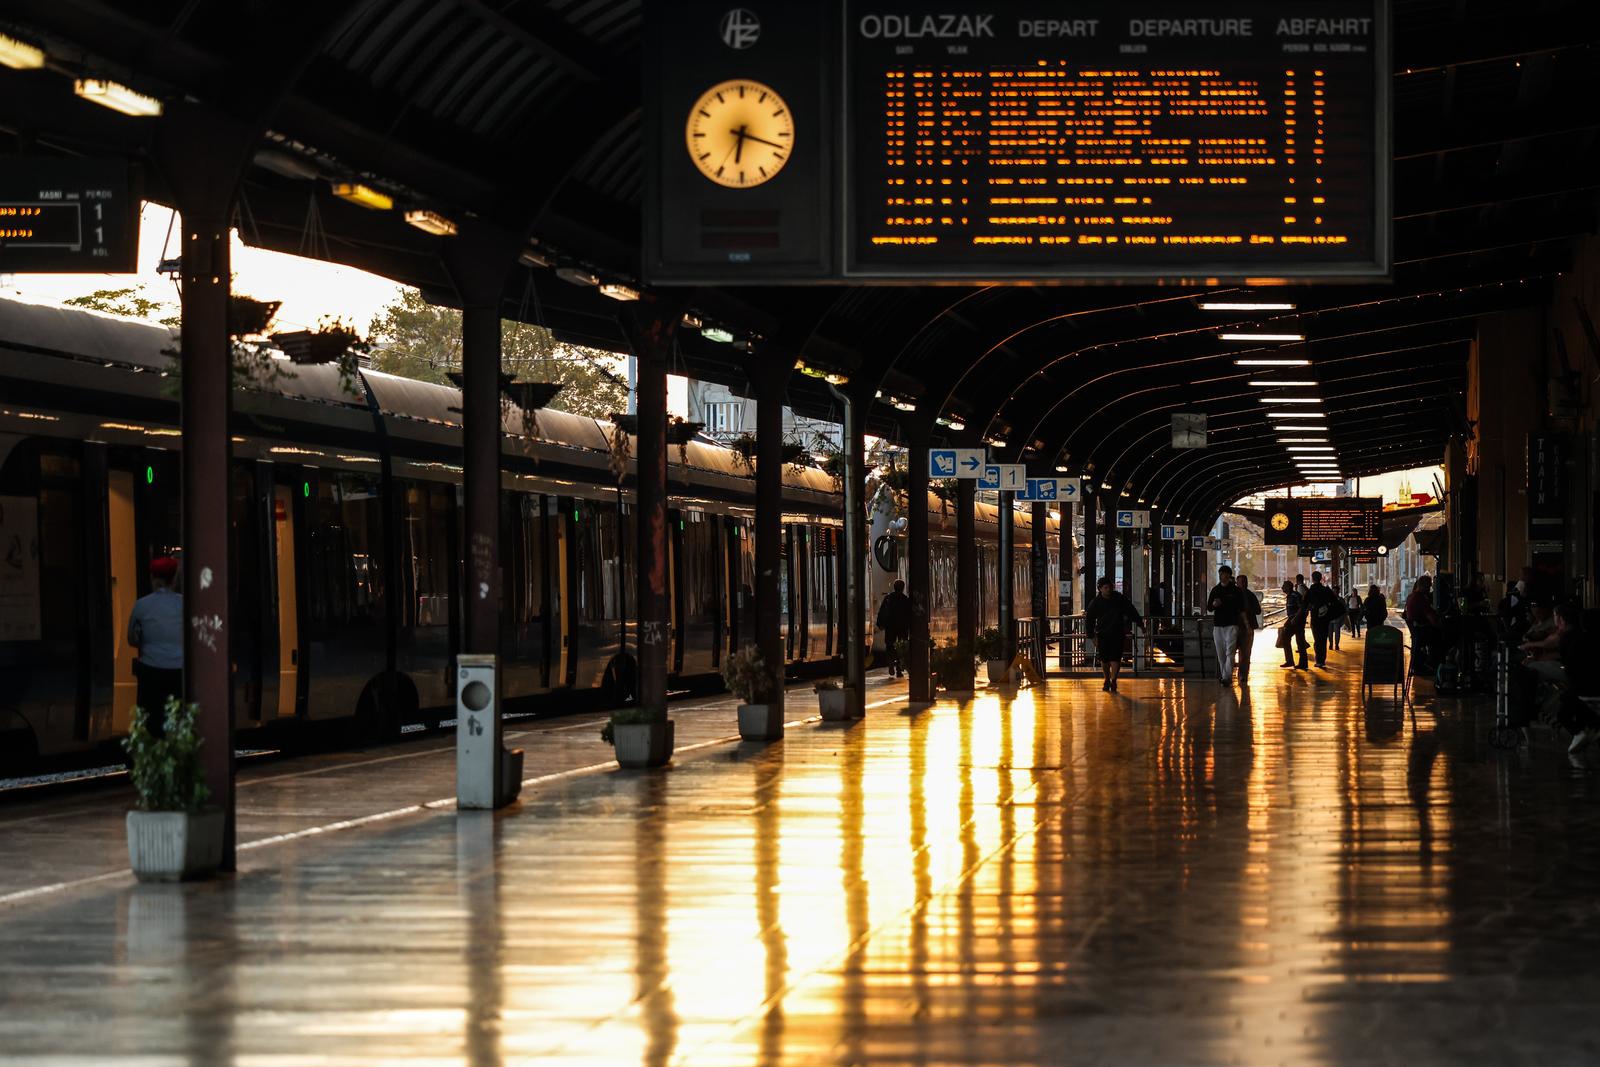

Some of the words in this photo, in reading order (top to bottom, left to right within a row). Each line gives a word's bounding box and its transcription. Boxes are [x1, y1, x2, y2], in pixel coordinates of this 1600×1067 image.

[860, 14, 995, 39] ODLAZAK
[1018, 19, 1100, 38] DEPART
[1129, 18, 1253, 37] DEPARTURE
[1276, 17, 1372, 36] ABFAHRT
[95, 203, 102, 221] 1
[95, 226, 103, 244] 1
[1008, 470, 1016, 486] 1
